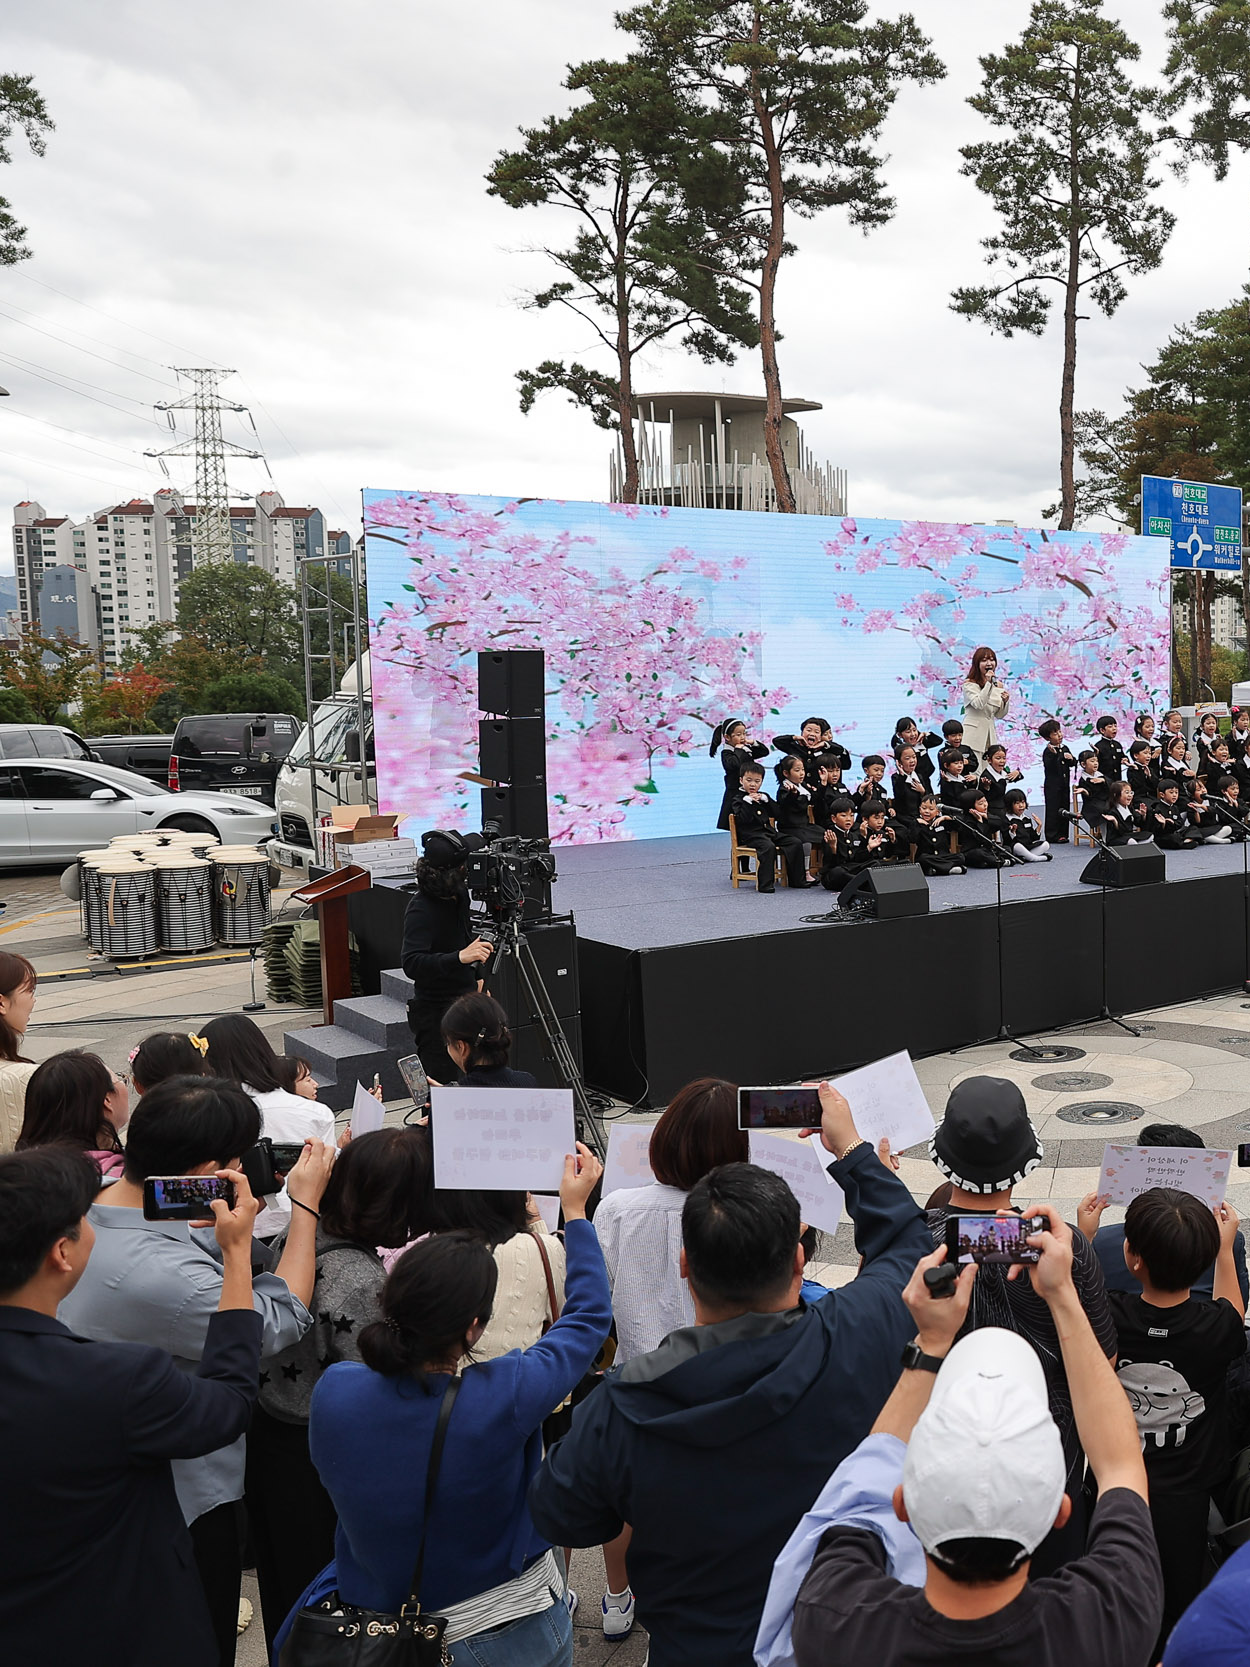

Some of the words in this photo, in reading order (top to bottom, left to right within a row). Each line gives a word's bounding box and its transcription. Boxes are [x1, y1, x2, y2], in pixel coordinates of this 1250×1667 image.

[1184, 488, 1207, 498] 천호대교
[1181, 502, 1209, 516] 천호대로
[1150, 520, 1170, 533] 아차산
[1214, 544, 1240, 558] 워커힐로
